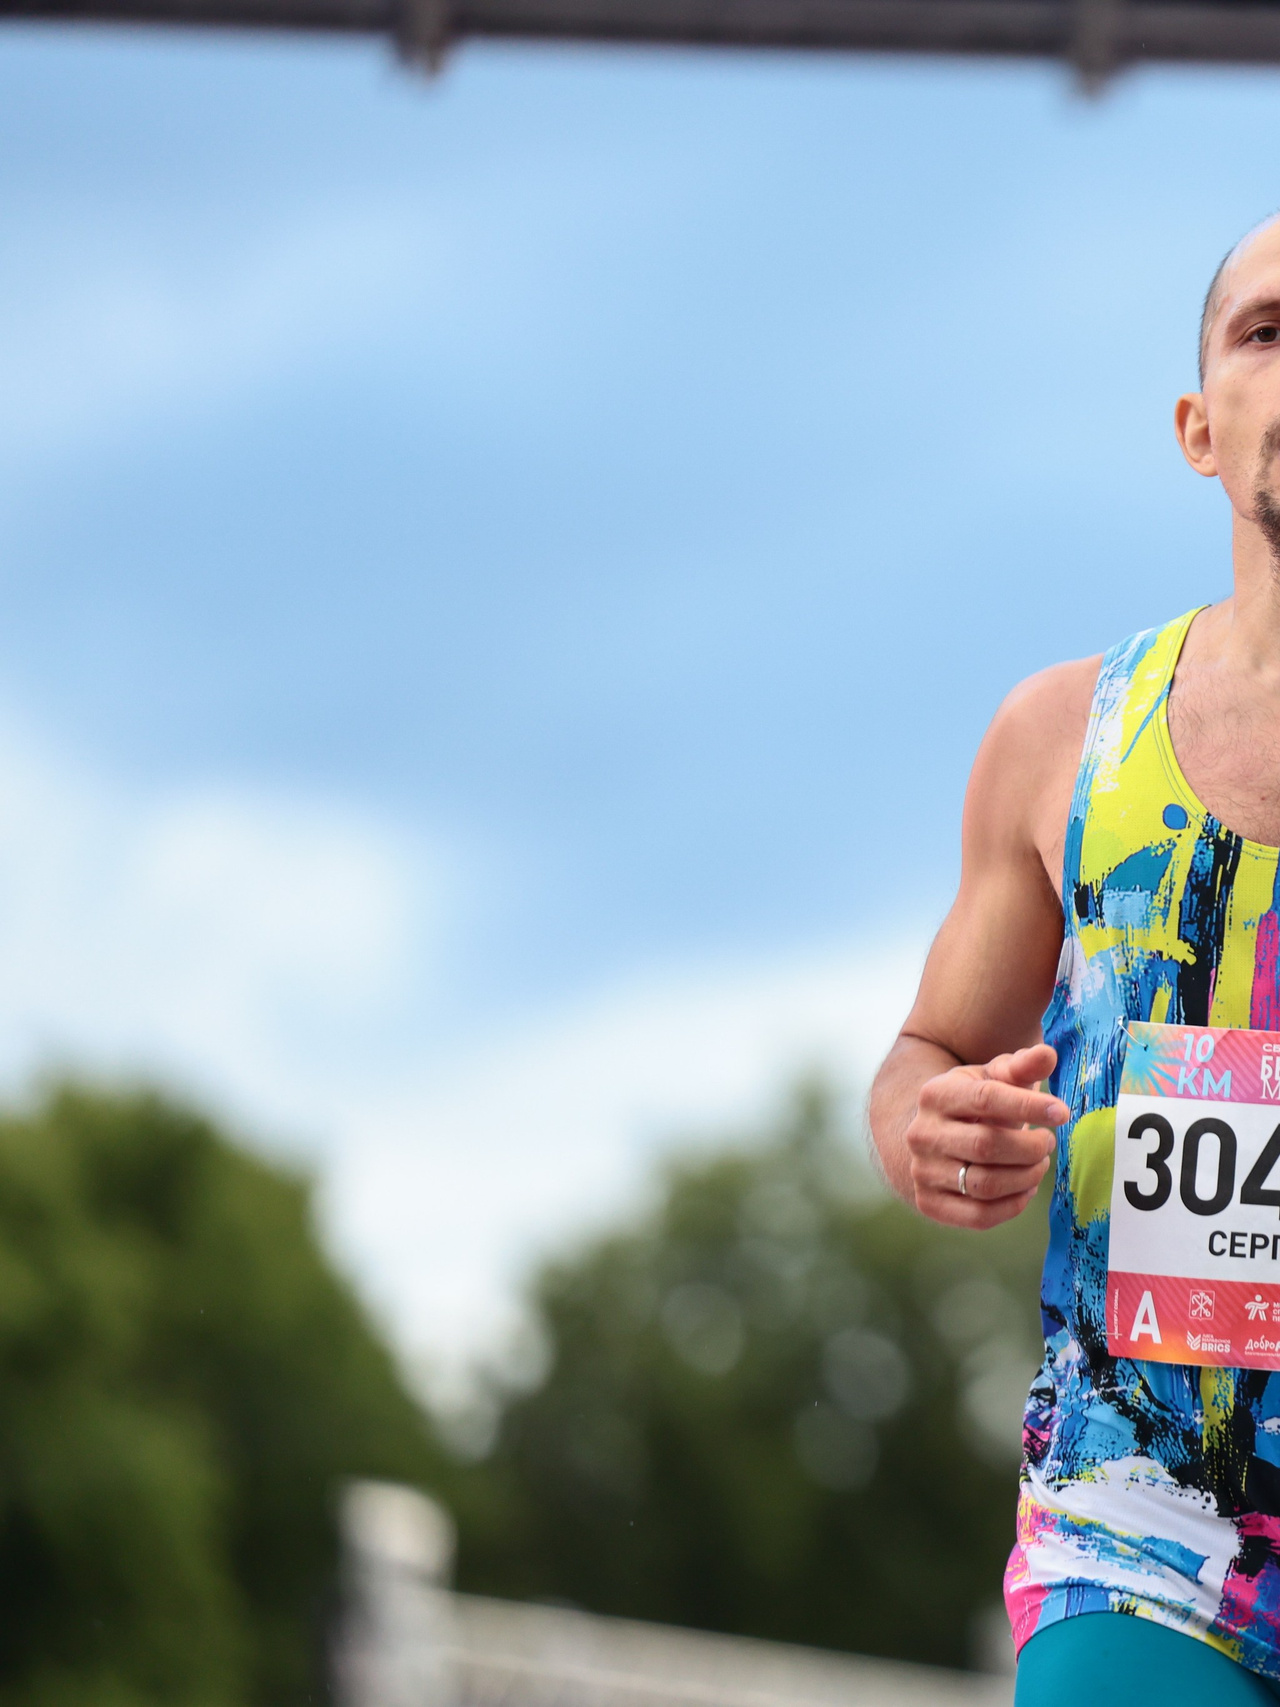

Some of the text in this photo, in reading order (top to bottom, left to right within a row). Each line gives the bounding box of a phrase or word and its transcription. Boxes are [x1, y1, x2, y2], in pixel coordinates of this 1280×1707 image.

[1184, 1033, 1215, 1063] 10
[1177, 1066, 1232, 1098] КМ
[1129, 1290, 1163, 1345] А
[1201, 1342, 1231, 1353] BRICS
